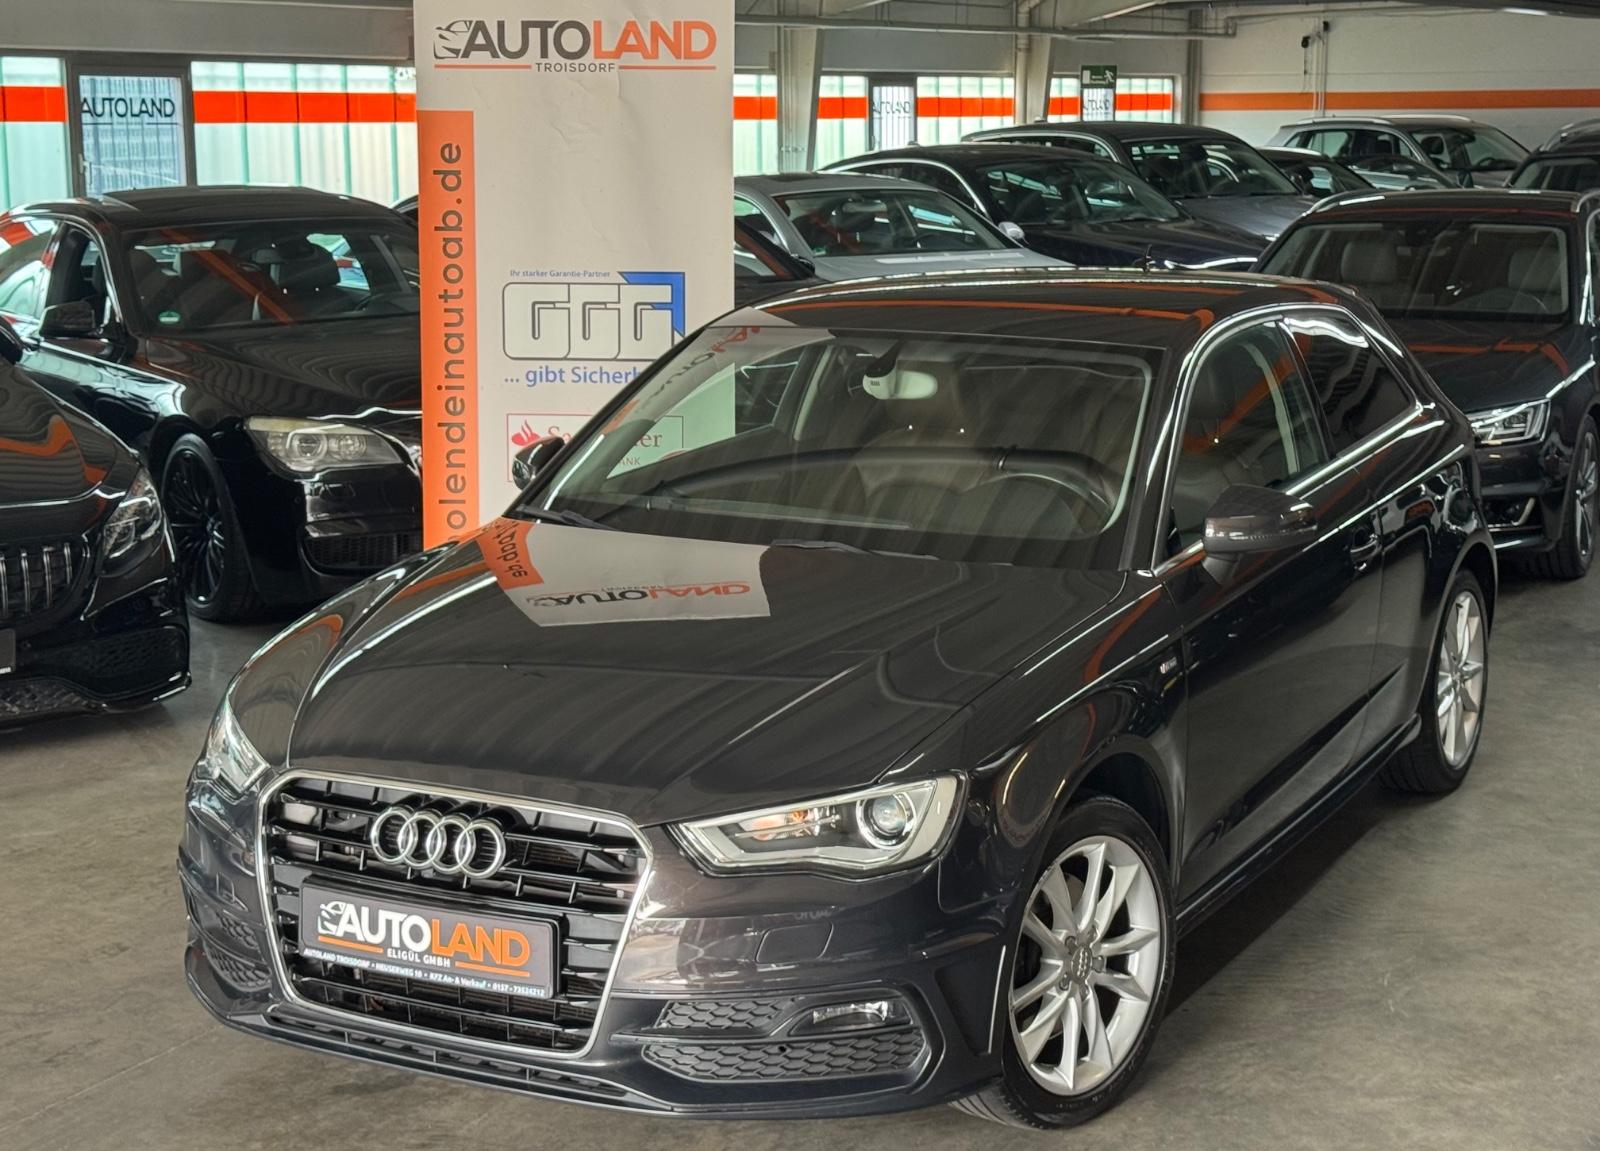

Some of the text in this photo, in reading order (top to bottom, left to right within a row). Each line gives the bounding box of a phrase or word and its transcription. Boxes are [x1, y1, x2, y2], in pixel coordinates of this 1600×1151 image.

[460, 20, 717, 60] AUTOLAND
[535, 62, 616, 73] TROISDORF
[81, 97, 175, 118] AUTOLAND
[510, 269, 611, 278] Ihr starker Garantie-Partner
[433, 142, 467, 541] olendeinautoab.de
[525, 365, 566, 388] gibt
[336, 902, 531, 967] AUTOLAND
[303, 947, 337, 962] AUTOLAND
[387, 947, 451, 968] ELIGÜL GMBH
